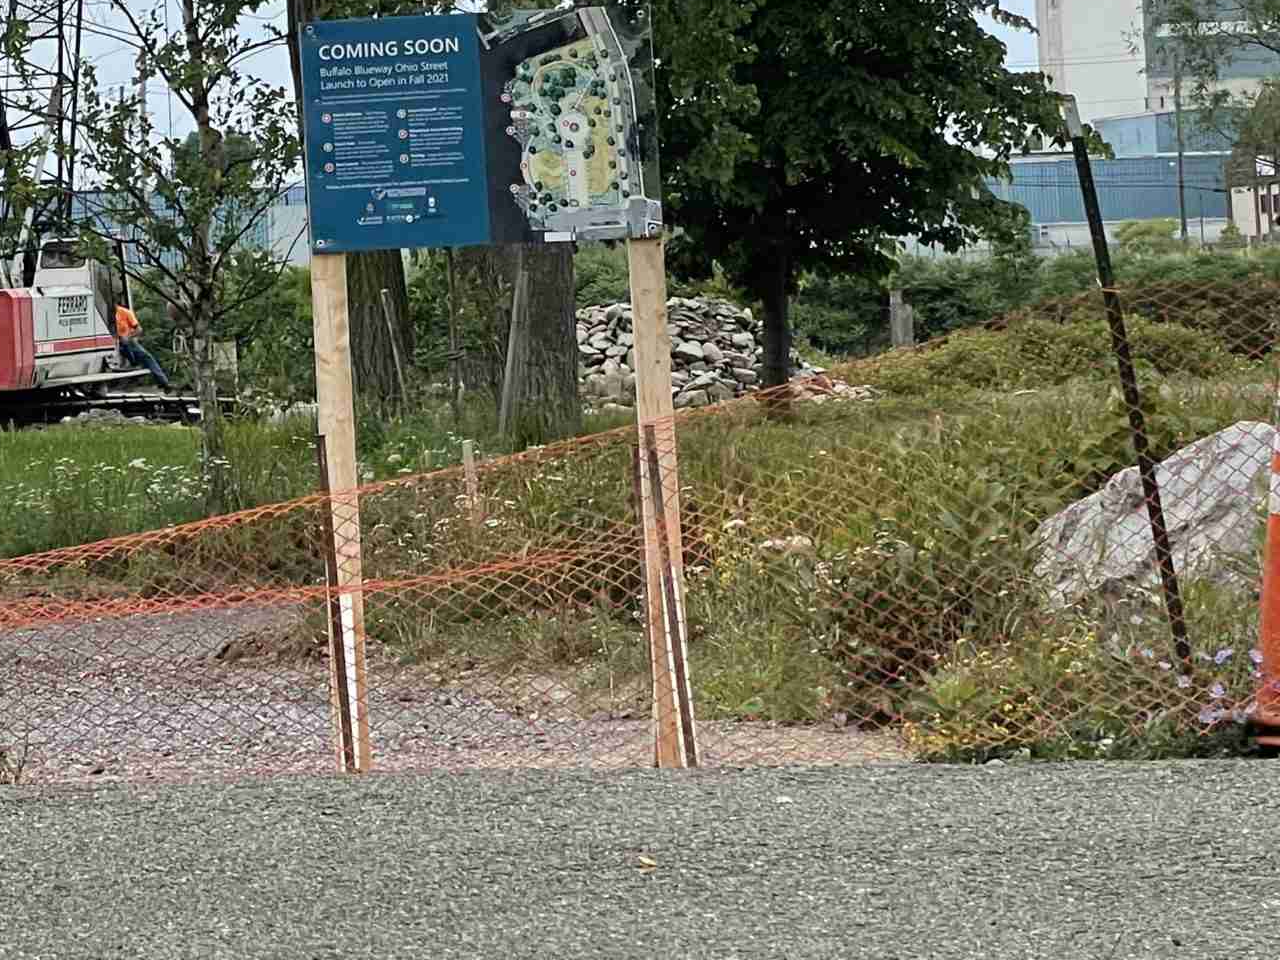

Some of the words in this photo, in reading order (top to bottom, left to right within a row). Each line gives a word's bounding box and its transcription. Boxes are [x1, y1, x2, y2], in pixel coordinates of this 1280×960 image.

[319, 41, 398, 60] COMING
[404, 37, 459, 55] SOON
[320, 66, 352, 78] Buffalo
[354, 64, 393, 76] Blueway
[395, 63, 418, 73] Ohio
[420, 61, 448, 72] Street
[320, 79, 354, 90] Launch
[356, 78, 366, 88] to
[368, 77, 396, 88] Open
[398, 75, 407, 85] in
[409, 74, 424, 85] Fall
[426, 73, 448, 84] 2021
